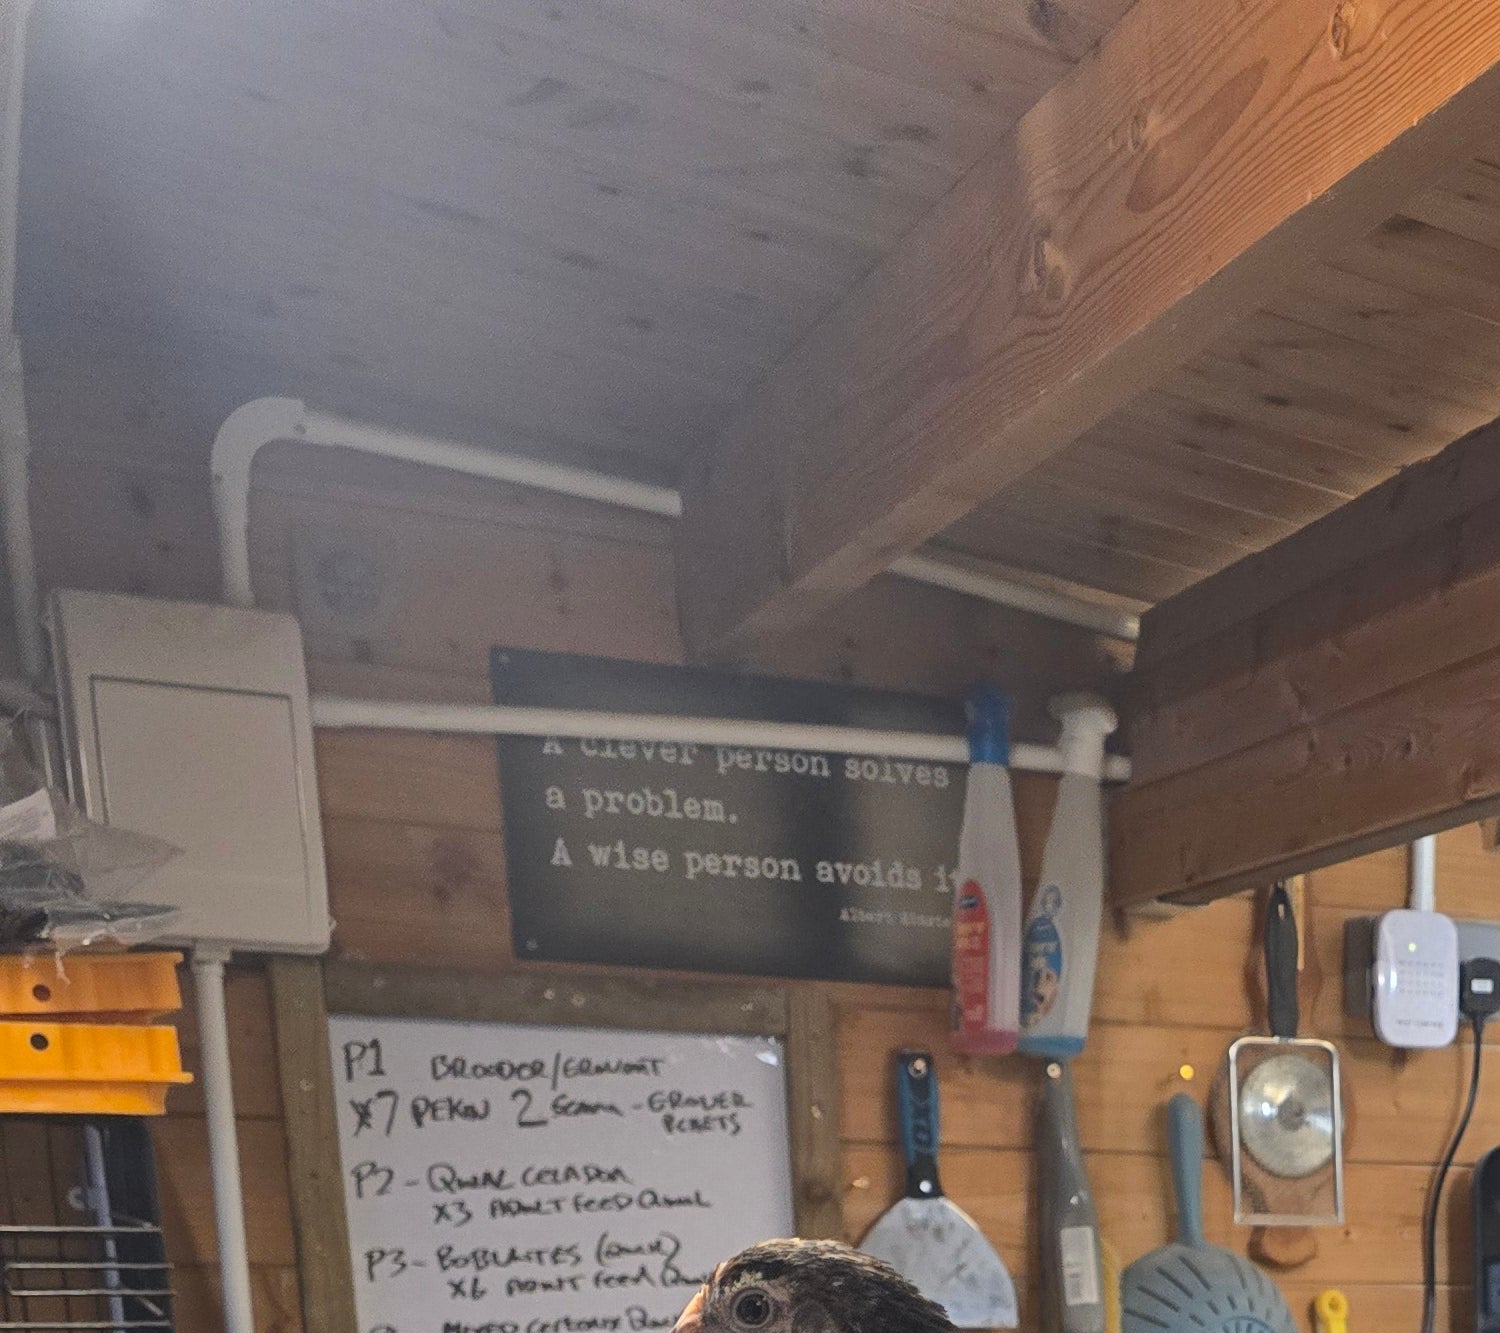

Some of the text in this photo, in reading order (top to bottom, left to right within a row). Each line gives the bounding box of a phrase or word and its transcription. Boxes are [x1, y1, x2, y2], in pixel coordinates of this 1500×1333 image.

[542, 736, 564, 755] A
[716, 748, 831, 777] person
[844, 757, 950, 788] solves
[545, 785, 739, 825] a problem.
[551, 837, 573, 868] A
[587, 839, 670, 873] wise
[683, 852, 803, 881] person
[815, 860, 922, 893] avoids
[343, 1038, 386, 1083] P1
[511, 1088, 549, 1128] 2
[351, 1160, 394, 1199] P2
[365, 1247, 407, 1283] P3
